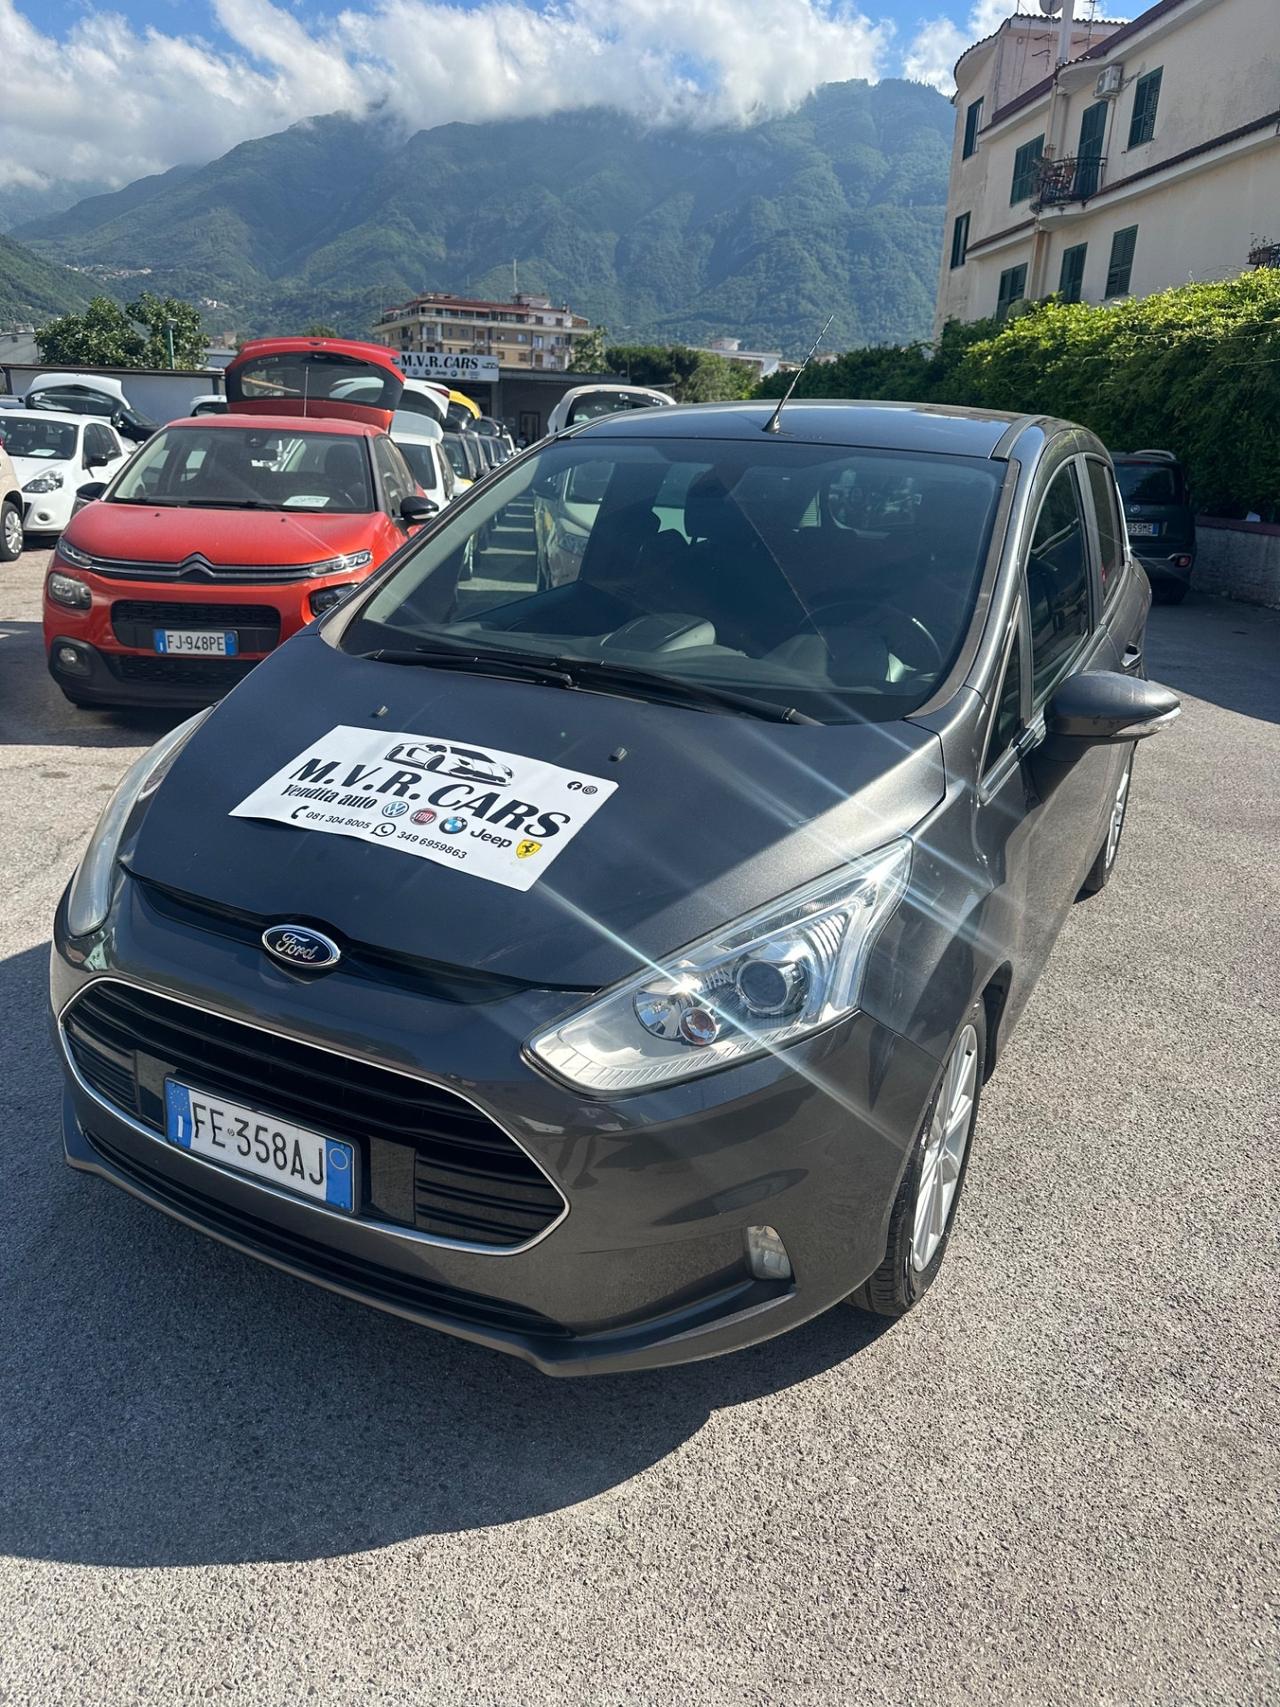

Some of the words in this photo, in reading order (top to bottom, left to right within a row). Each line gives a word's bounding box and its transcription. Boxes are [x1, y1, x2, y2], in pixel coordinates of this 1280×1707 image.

[280, 784, 340, 803] Vendita
[337, 794, 378, 809] auto
[305, 811, 326, 821] 081
[325, 815, 344, 824] 304
[344, 818, 372, 829] 8005
[397, 831, 419, 843] 349
[418, 837, 468, 860] 6959863
[470, 829, 512, 848] Jeep
[275, 932, 319, 960] Ford
